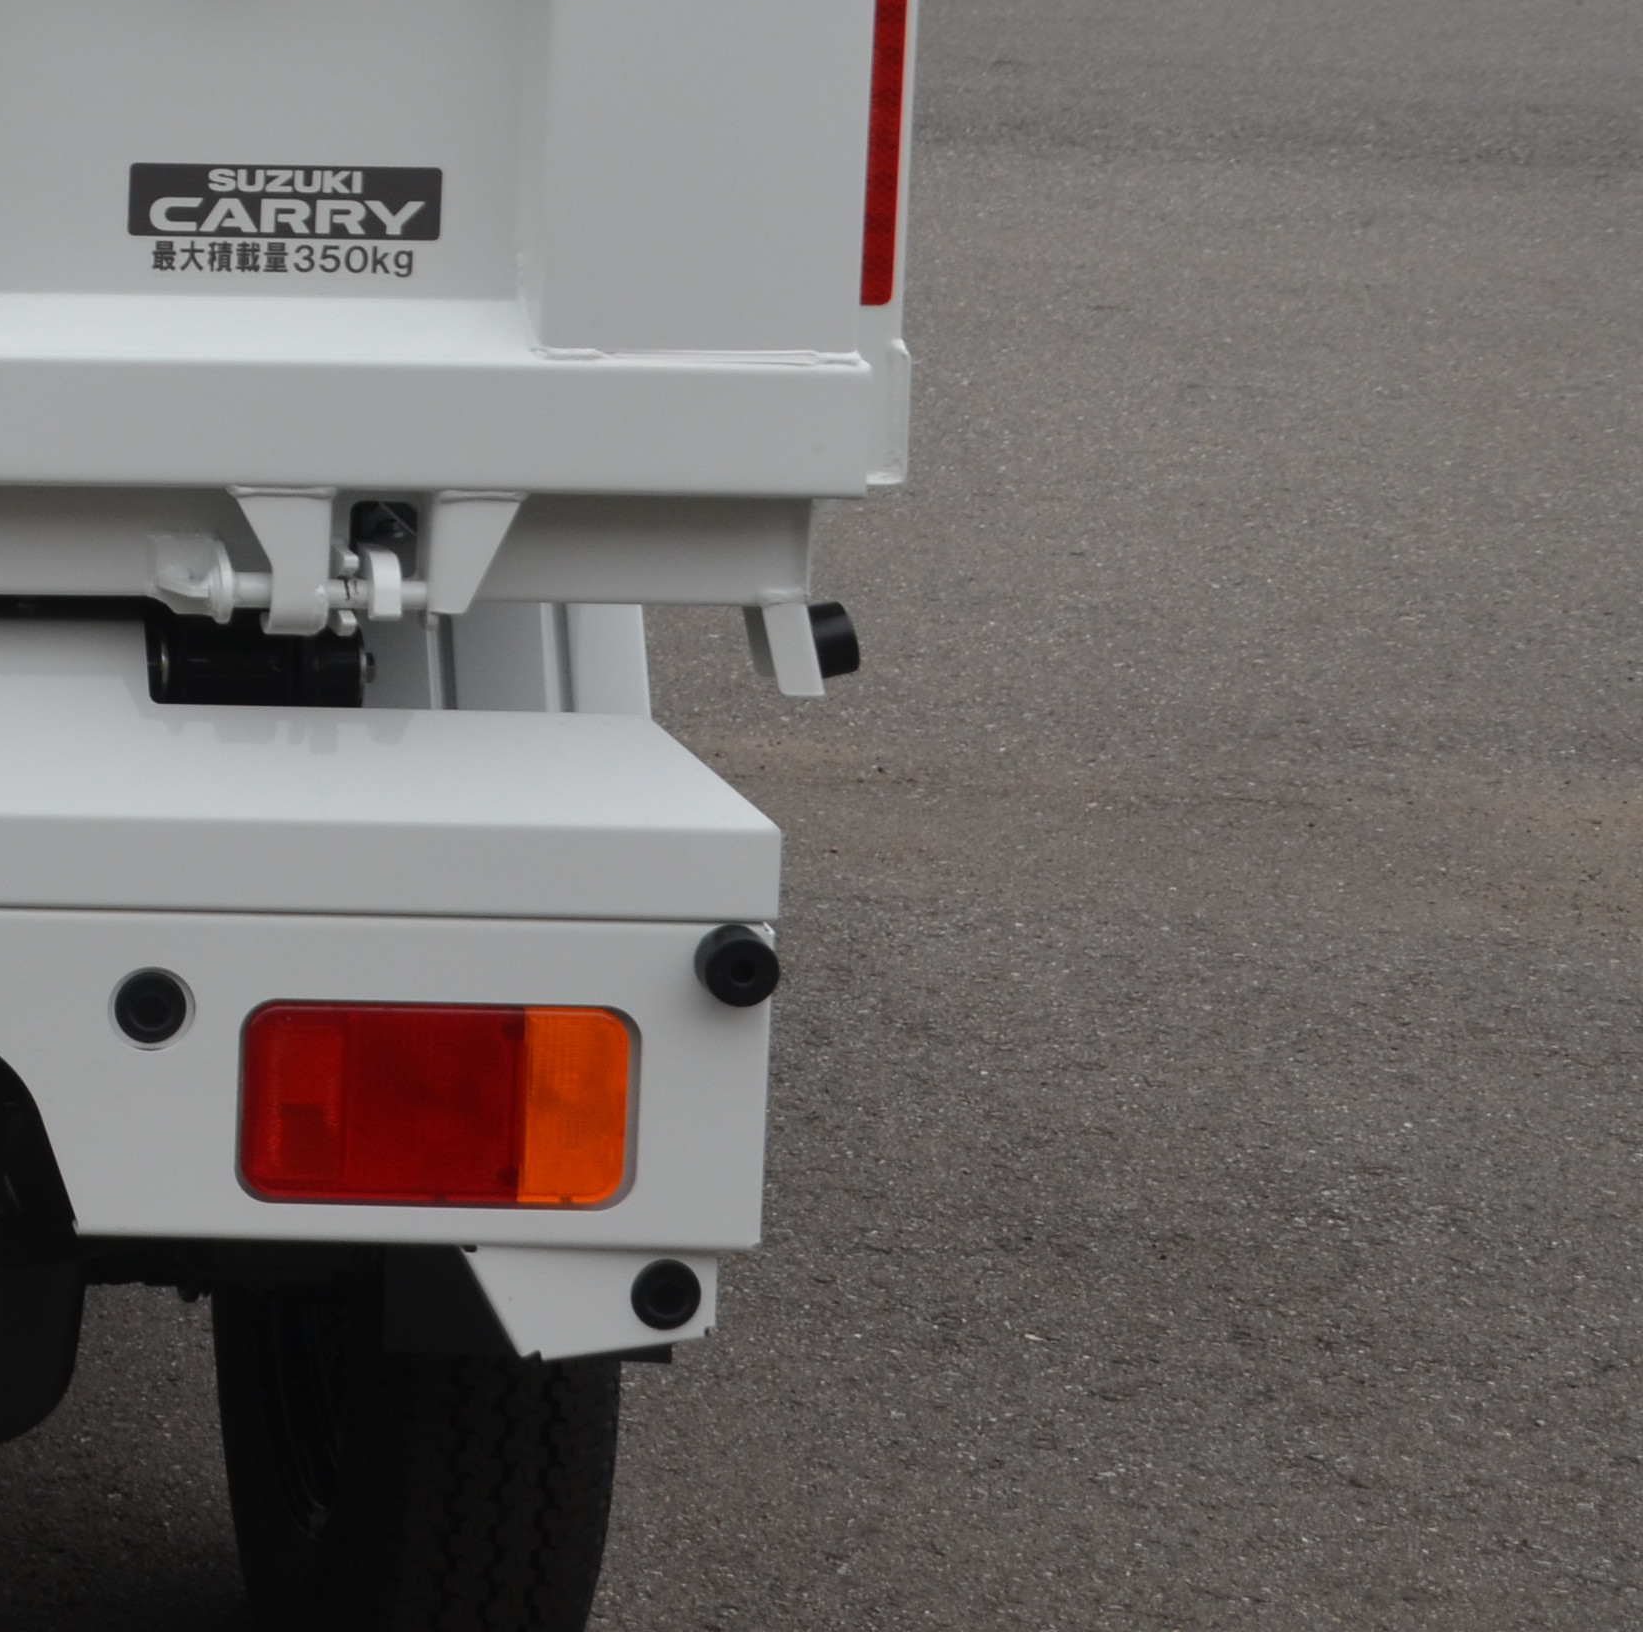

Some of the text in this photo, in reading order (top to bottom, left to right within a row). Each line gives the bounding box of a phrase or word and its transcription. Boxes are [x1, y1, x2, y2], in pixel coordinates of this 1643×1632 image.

[208, 168, 363, 194] SUZUKI
[149, 196, 426, 236] CARRY
[151, 240, 414, 278] 最大積載量350kg
